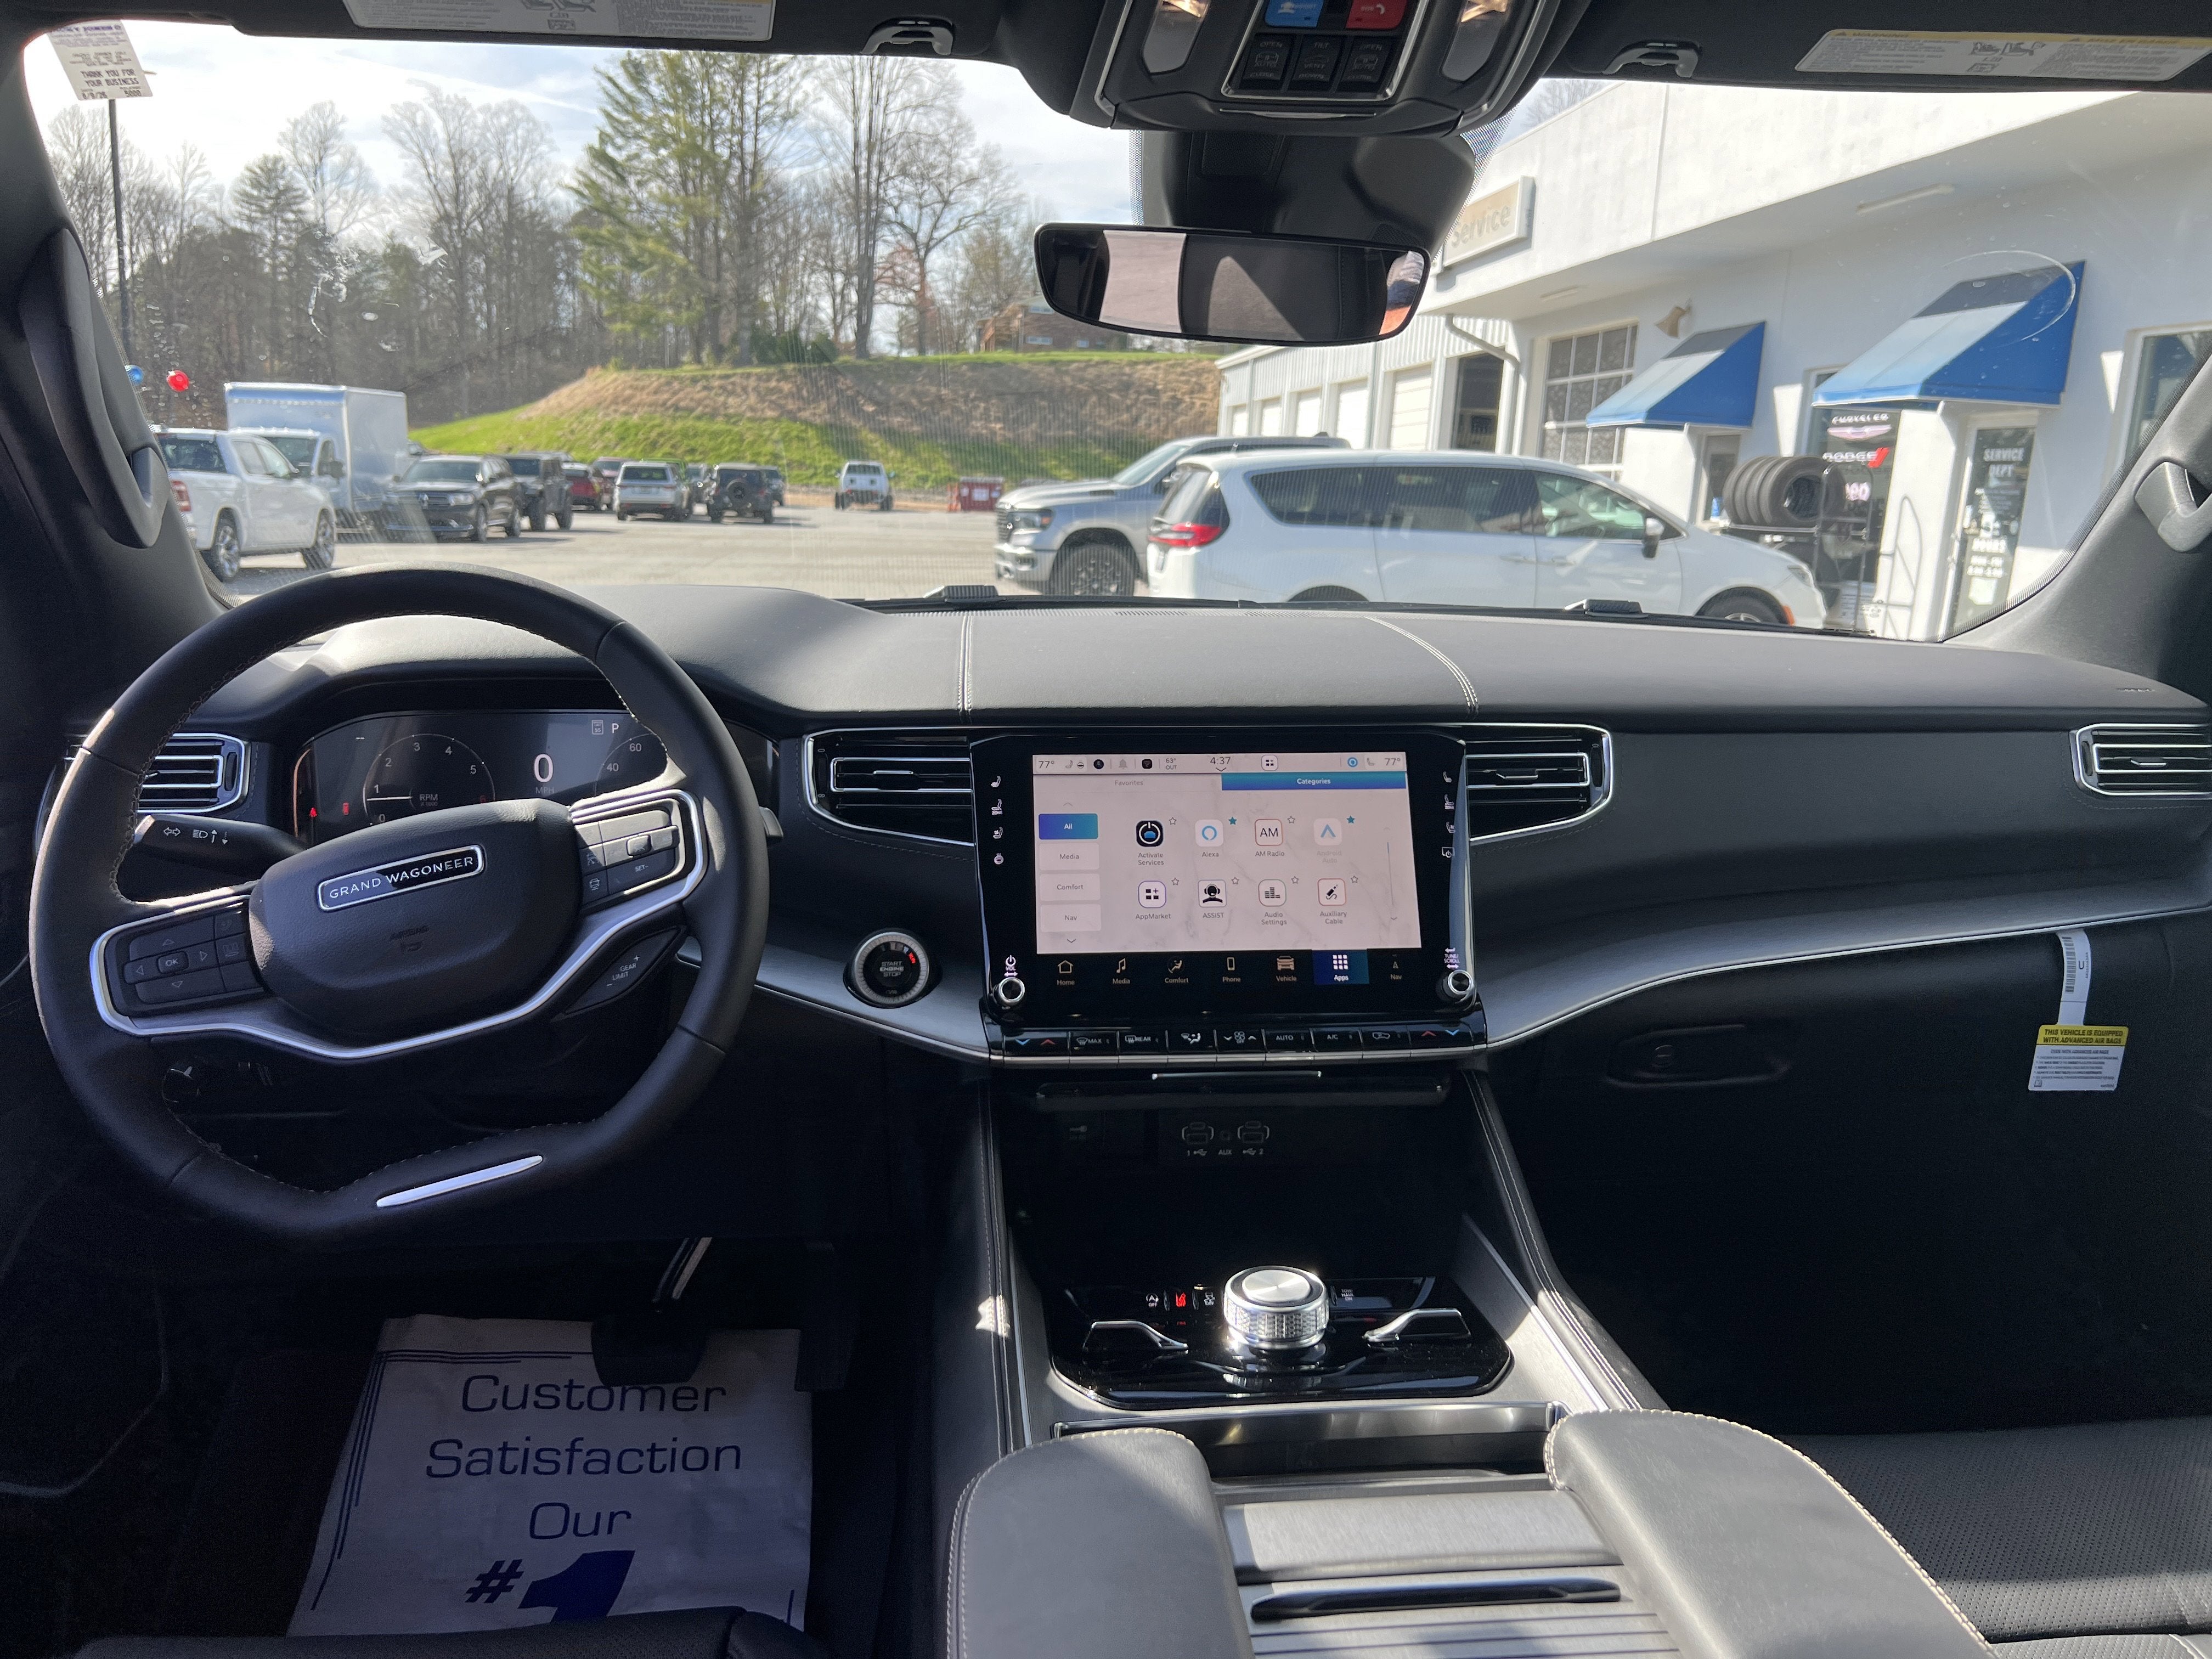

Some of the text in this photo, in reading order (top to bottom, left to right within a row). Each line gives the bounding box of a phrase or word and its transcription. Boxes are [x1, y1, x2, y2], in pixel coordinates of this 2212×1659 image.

[105, 78, 139, 86] BUSINESS
[1822, 452, 1878, 463] DODGE
[1983, 447, 2024, 462] SERVICE
[612, 723, 619, 733] P
[414, 742, 420, 752] 3
[445, 746, 453, 755] 4
[629, 743, 642, 752] 60
[385, 758, 392, 767] 2
[1038, 760, 1055, 769] 77°
[1210, 757, 1231, 765] 4:37
[1385, 758, 1401, 766] 77°
[470, 765, 477, 775] 5
[534, 754, 554, 783] 0
[606, 763, 619, 772] 40
[1296, 777, 1331, 786] Categories
[374, 784, 379, 793] 1
[535, 786, 555, 794] MPH
[379, 814, 386, 822] 0
[1260, 827, 1279, 837] AM
[329, 856, 473, 899] GRAND WAGONEER
[166, 958, 179, 967] OK
[620, 963, 637, 972] GEAR
[612, 971, 629, 981] LIMIT
[1334, 974, 1349, 983] Apps
[462, 1374, 727, 1413] Customer
[426, 1436, 742, 1479] Satisfaction
[529, 1502, 632, 1540] Our
